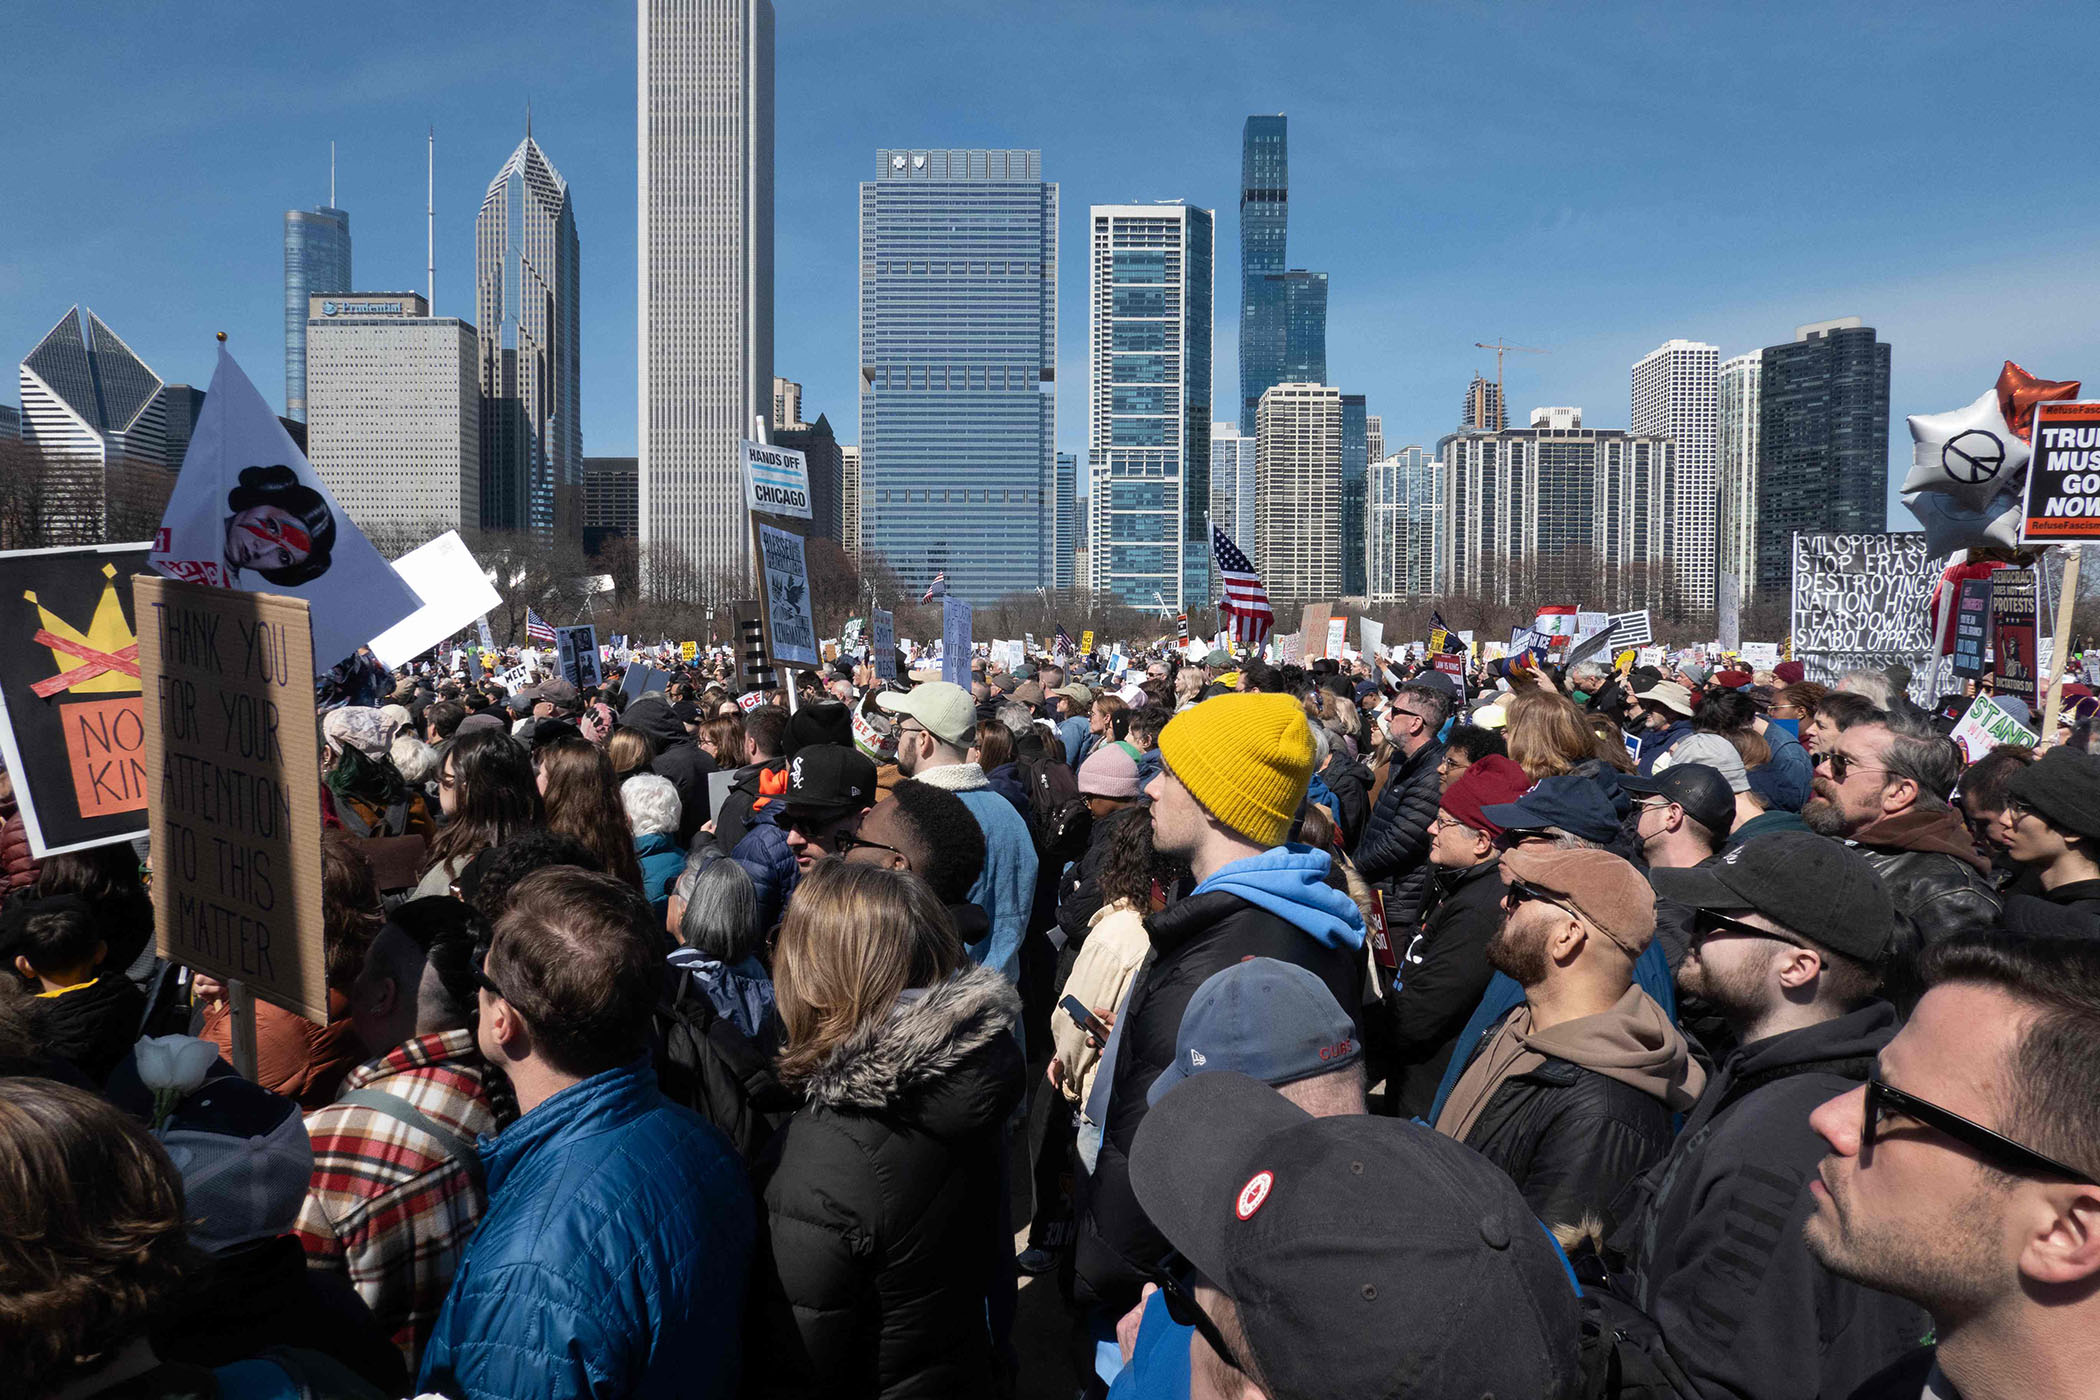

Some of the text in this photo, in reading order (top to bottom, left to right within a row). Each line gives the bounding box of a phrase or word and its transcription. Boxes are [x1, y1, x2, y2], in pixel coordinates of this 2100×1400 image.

[342, 302, 402, 313] Prudential
[2042, 428, 2100, 449] TRU
[749, 448, 800, 469] HANDS OFF
[2062, 474, 2100, 495] GO
[755, 485, 806, 507] CHICAGO
[1798, 534, 1928, 555] EVIL OPPRESS
[1797, 553, 1852, 573] STOP
[1797, 573, 1927, 595] DESTROYING
[1993, 571, 2035, 584] DEMOCRACY
[1797, 592, 1875, 613] NATION
[1993, 597, 2036, 614] PROTESTS
[1795, 609, 1850, 631] TEAR
[1855, 611, 1907, 631] DOWN
[151, 602, 288, 687] THANK YOU
[1796, 628, 1863, 650] SYMBOL
[505, 665, 527, 684] MELT
[1996, 677, 2034, 692] DICTATORS DO
[739, 694, 761, 711] ICE
[158, 674, 285, 767] FOR YOUR
[1970, 696, 2035, 749] STAND
[79, 708, 144, 758] NO
[161, 749, 292, 844] ATTENTION
[166, 819, 275, 912] TO THIS
[178, 891, 275, 981] MATTER
[1319, 1037, 1353, 1061] CUBS
